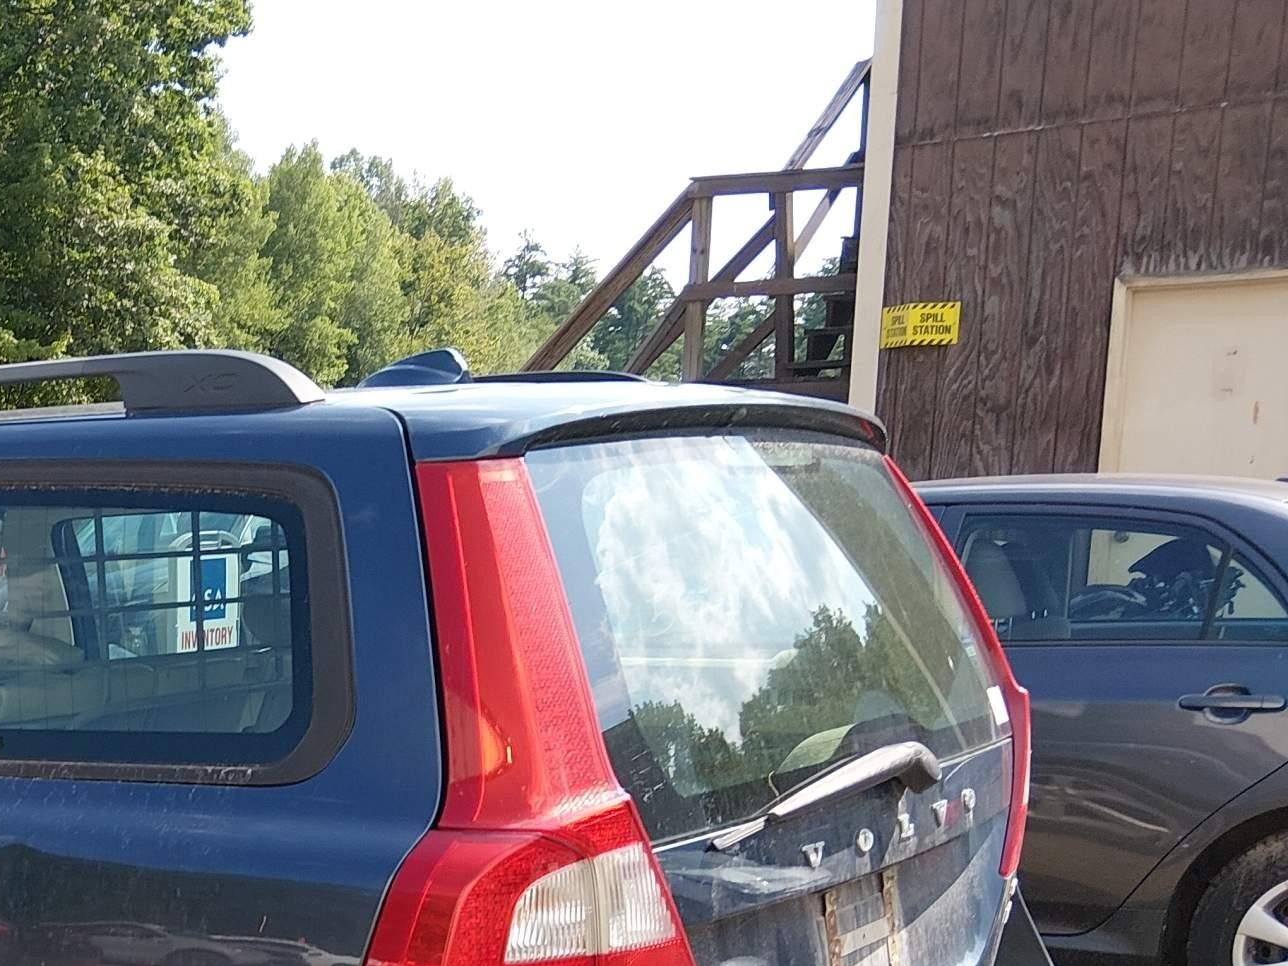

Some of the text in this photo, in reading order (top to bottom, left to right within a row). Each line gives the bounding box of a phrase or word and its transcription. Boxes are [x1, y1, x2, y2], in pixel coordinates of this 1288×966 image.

[920, 312, 946, 324] SPILL
[912, 324, 952, 336] STATION
[181, 625, 233, 650] INVNTORY
[801, 787, 976, 868] VOLVO
